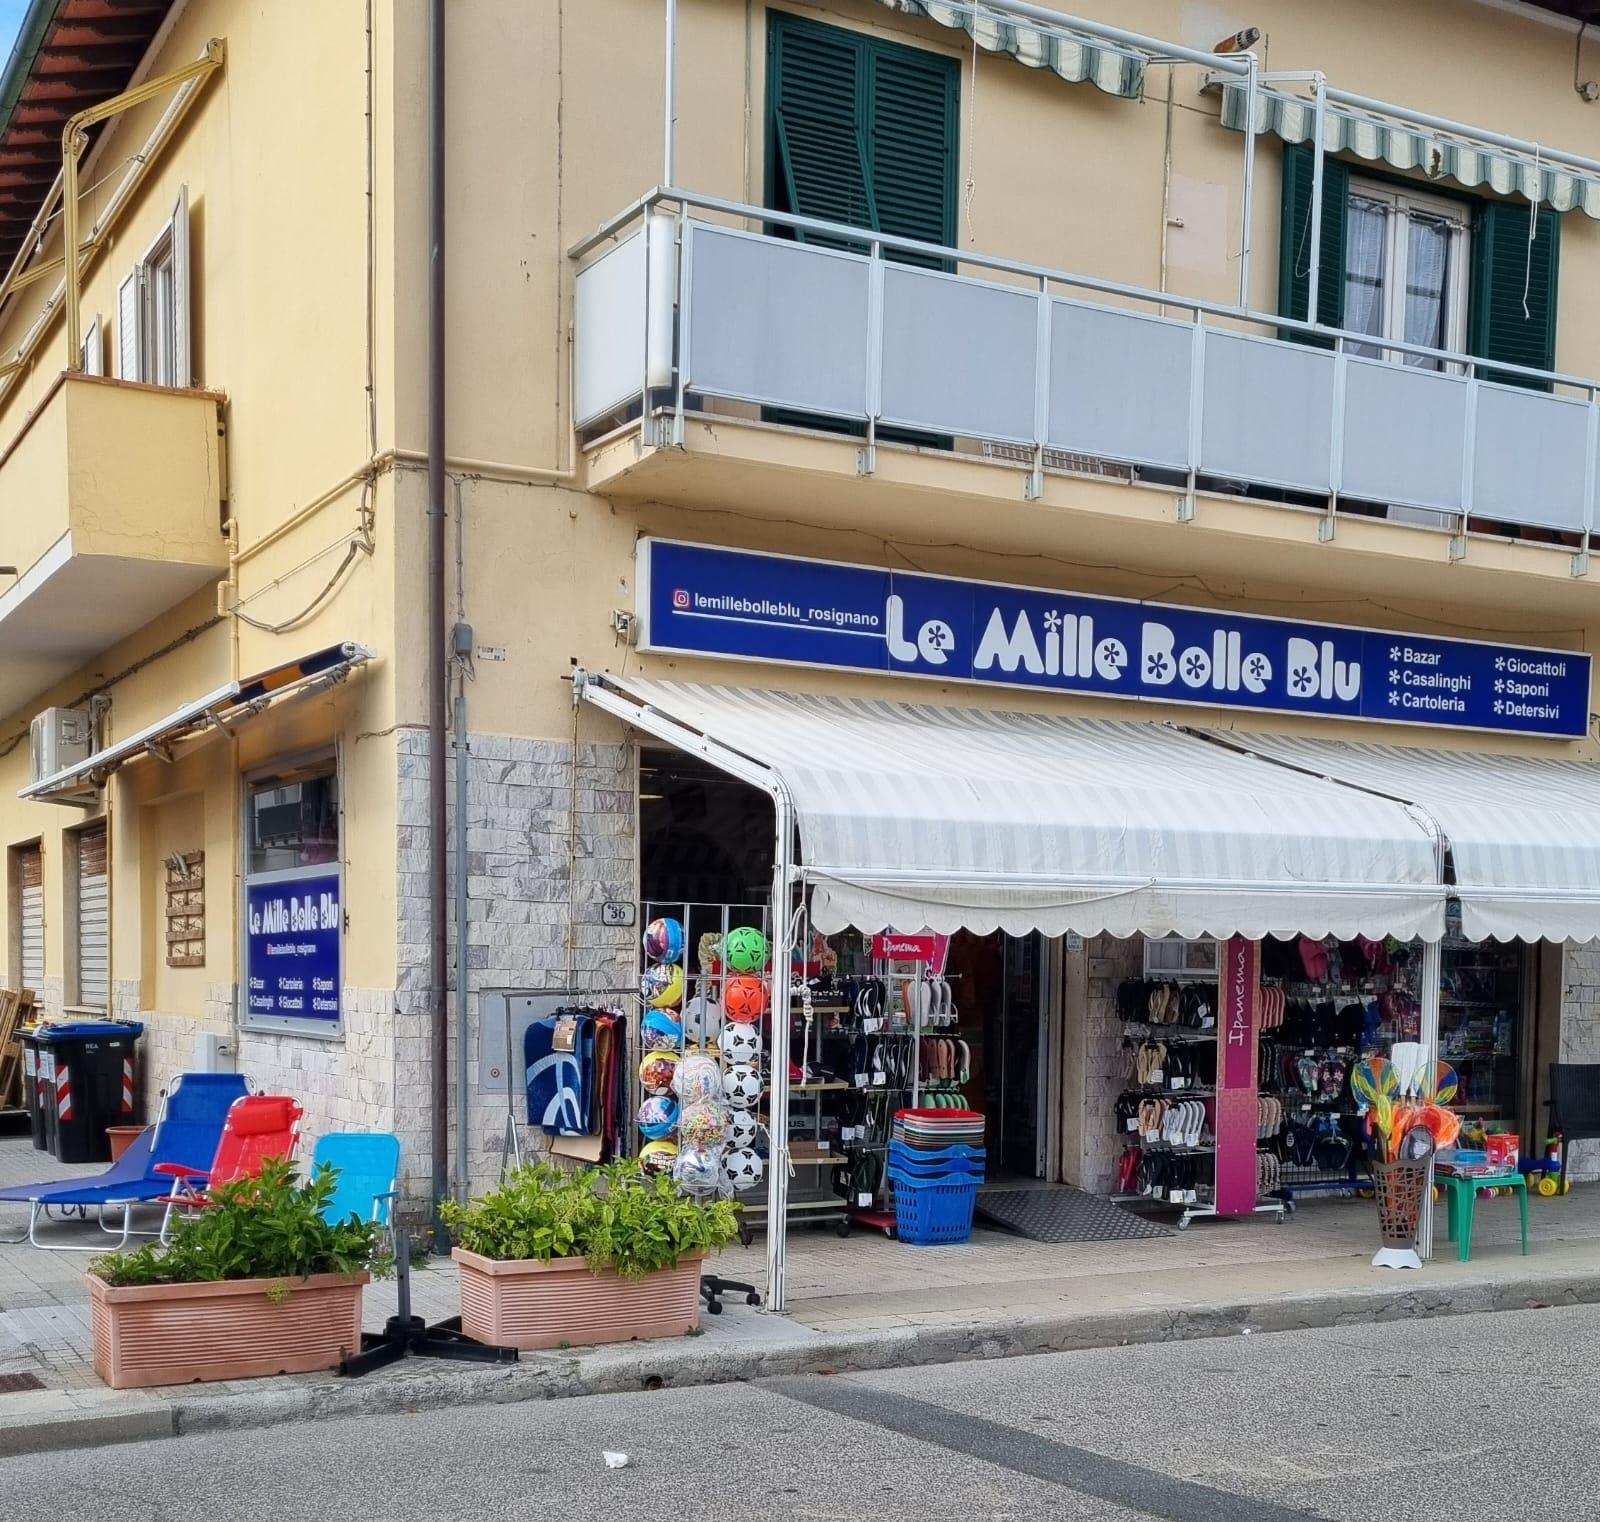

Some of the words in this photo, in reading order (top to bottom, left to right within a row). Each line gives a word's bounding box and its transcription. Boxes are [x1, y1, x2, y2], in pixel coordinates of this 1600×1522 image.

[694, 592, 880, 626] lemillebolleblu_rosignano
[886, 594, 955, 664] Le
[973, 607, 1128, 681] Mille
[1140, 622, 1272, 694] Bolle
[1287, 637, 1361, 701] Blu
[1403, 647, 1441, 666] Bazar
[1507, 657, 1566, 677] Giocattoli
[1402, 670, 1471, 693] Casalinghi
[1506, 679, 1549, 698] Saponi
[1402, 692, 1465, 712] Cartoleria
[1505, 702, 1559, 720] Detersivi
[249, 903, 261, 935] Le
[262, 898, 289, 934] Mille
[291, 895, 318, 932] Bolle
[320, 892, 338, 930] Blu
[1228, 945, 1249, 1046] Ipanema
